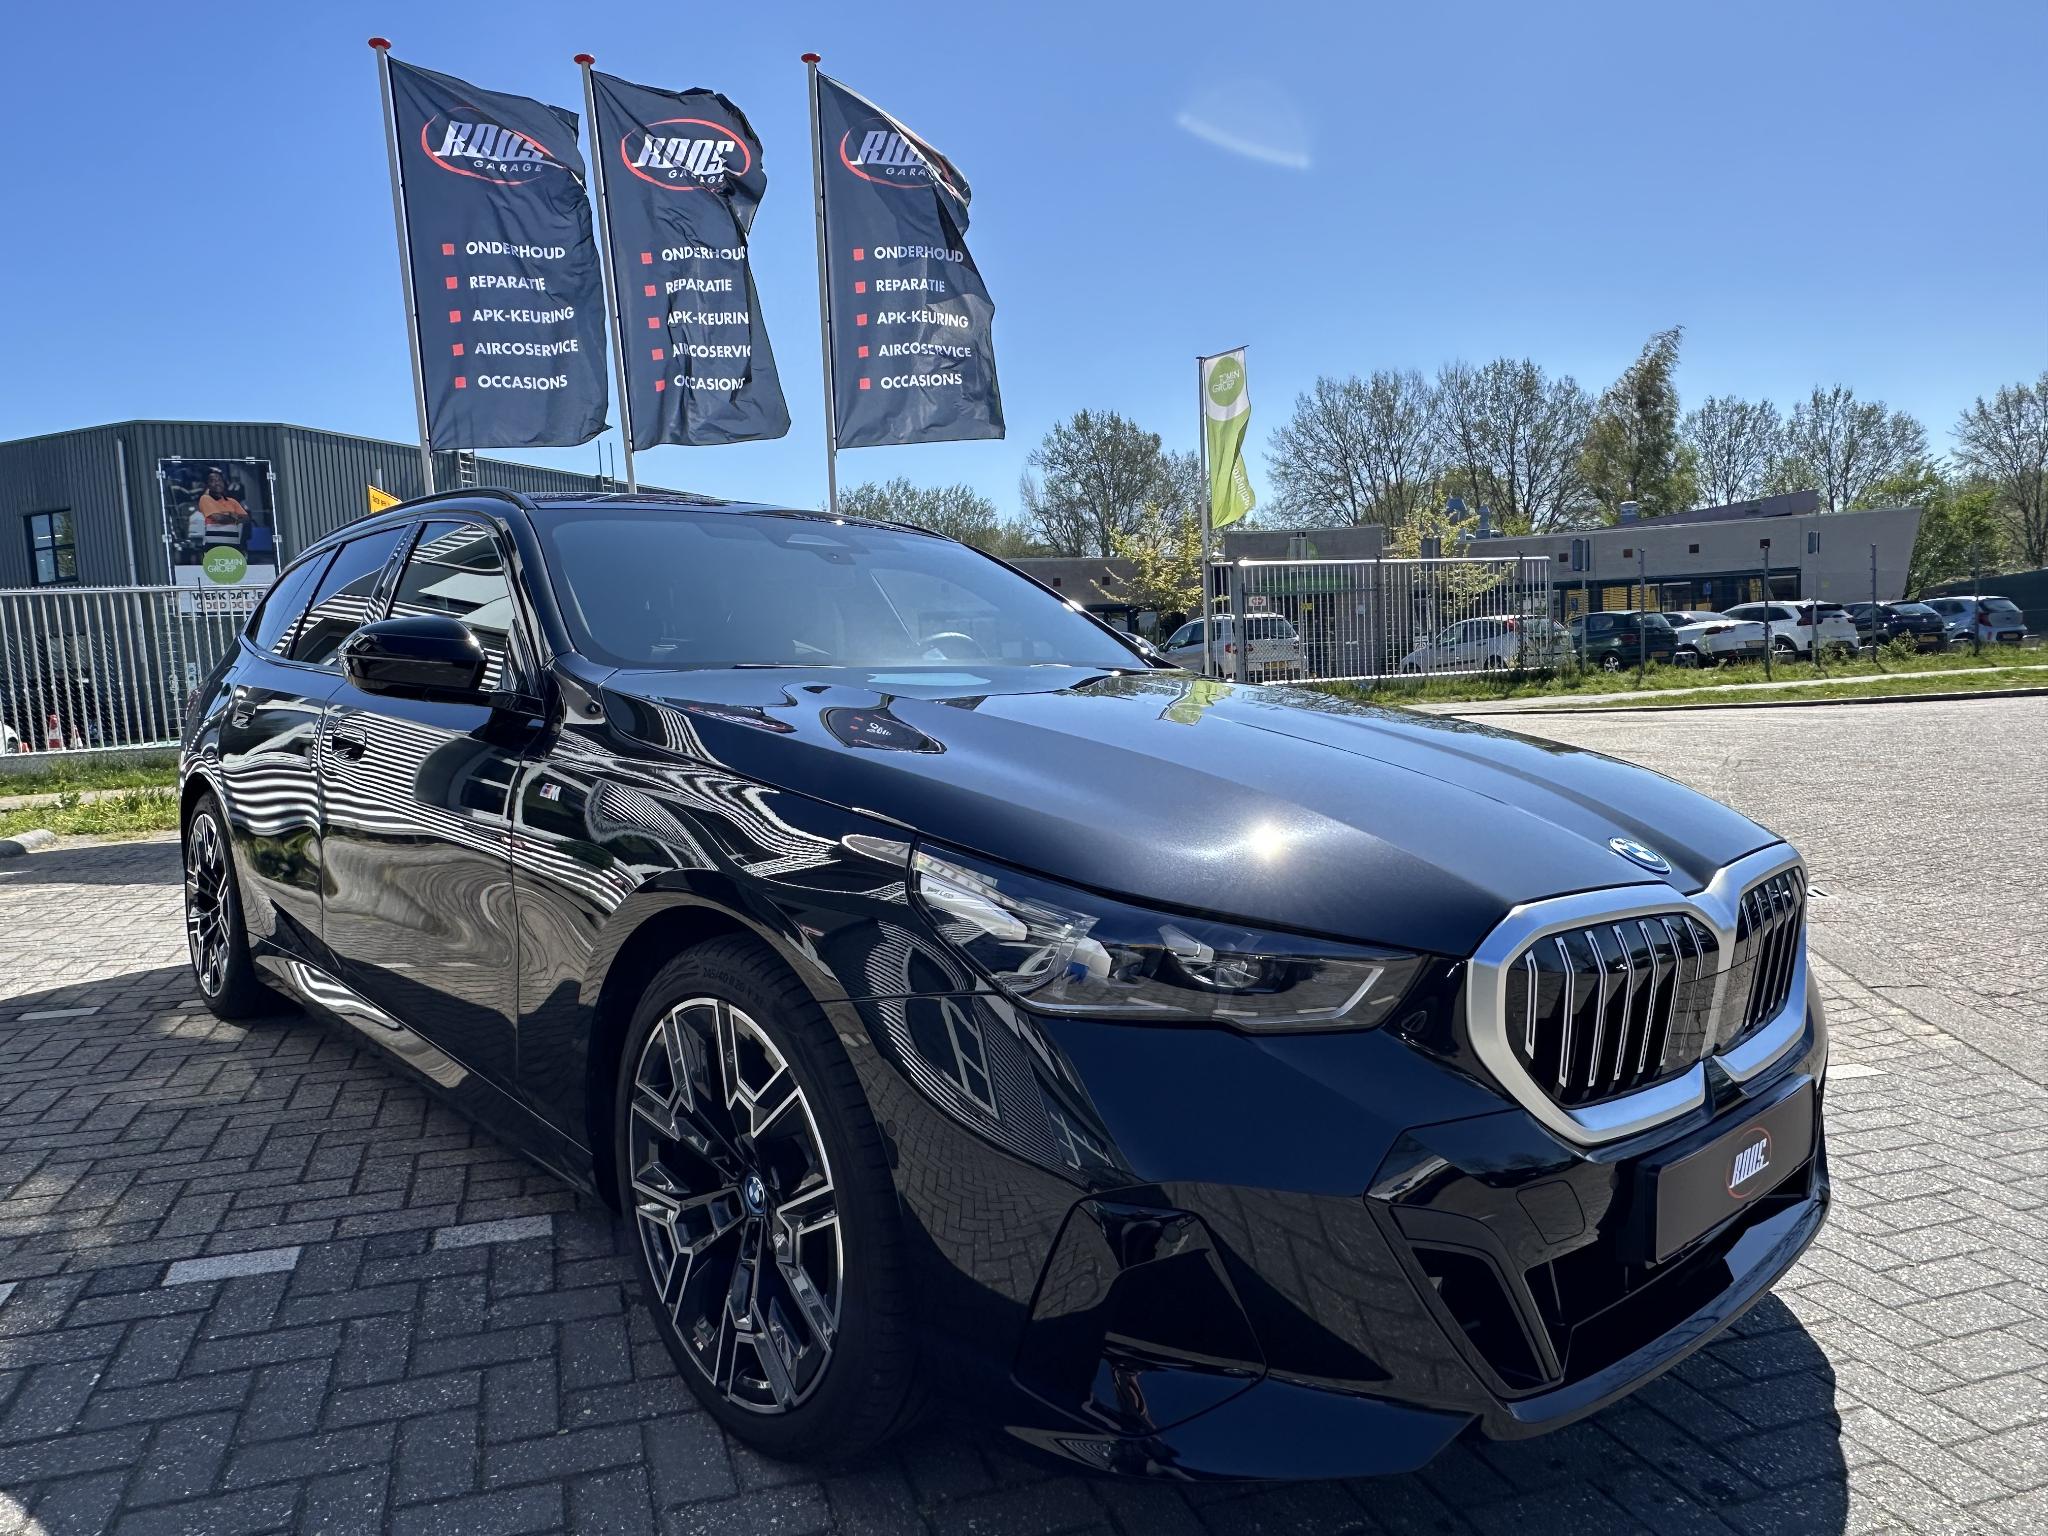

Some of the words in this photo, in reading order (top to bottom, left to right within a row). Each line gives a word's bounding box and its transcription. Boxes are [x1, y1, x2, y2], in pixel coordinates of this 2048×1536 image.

[632, 134, 736, 175] ROOS
[473, 160, 544, 172] GARAGE
[885, 167, 926, 176] GARA
[466, 241, 566, 259] ONDERHOUD
[874, 245, 964, 263] ONDERHOUD
[469, 275, 546, 291] REPARATIE
[665, 278, 733, 294] REPARATIE
[876, 278, 946, 293] REPARATIE
[472, 306, 575, 324] APK-KEURING
[667, 311, 749, 325] APK-KEURIN
[877, 310, 969, 328] APK-KEURING
[475, 339, 578, 356] AIRCOSERVICE
[879, 342, 972, 358] AIRCOSERVICE
[477, 374, 568, 390] OCCASIONS
[674, 374, 746, 391] OCCASIONS
[880, 373, 963, 390] OCCASIONS
[1729, 1138, 1769, 1188] ROOS
